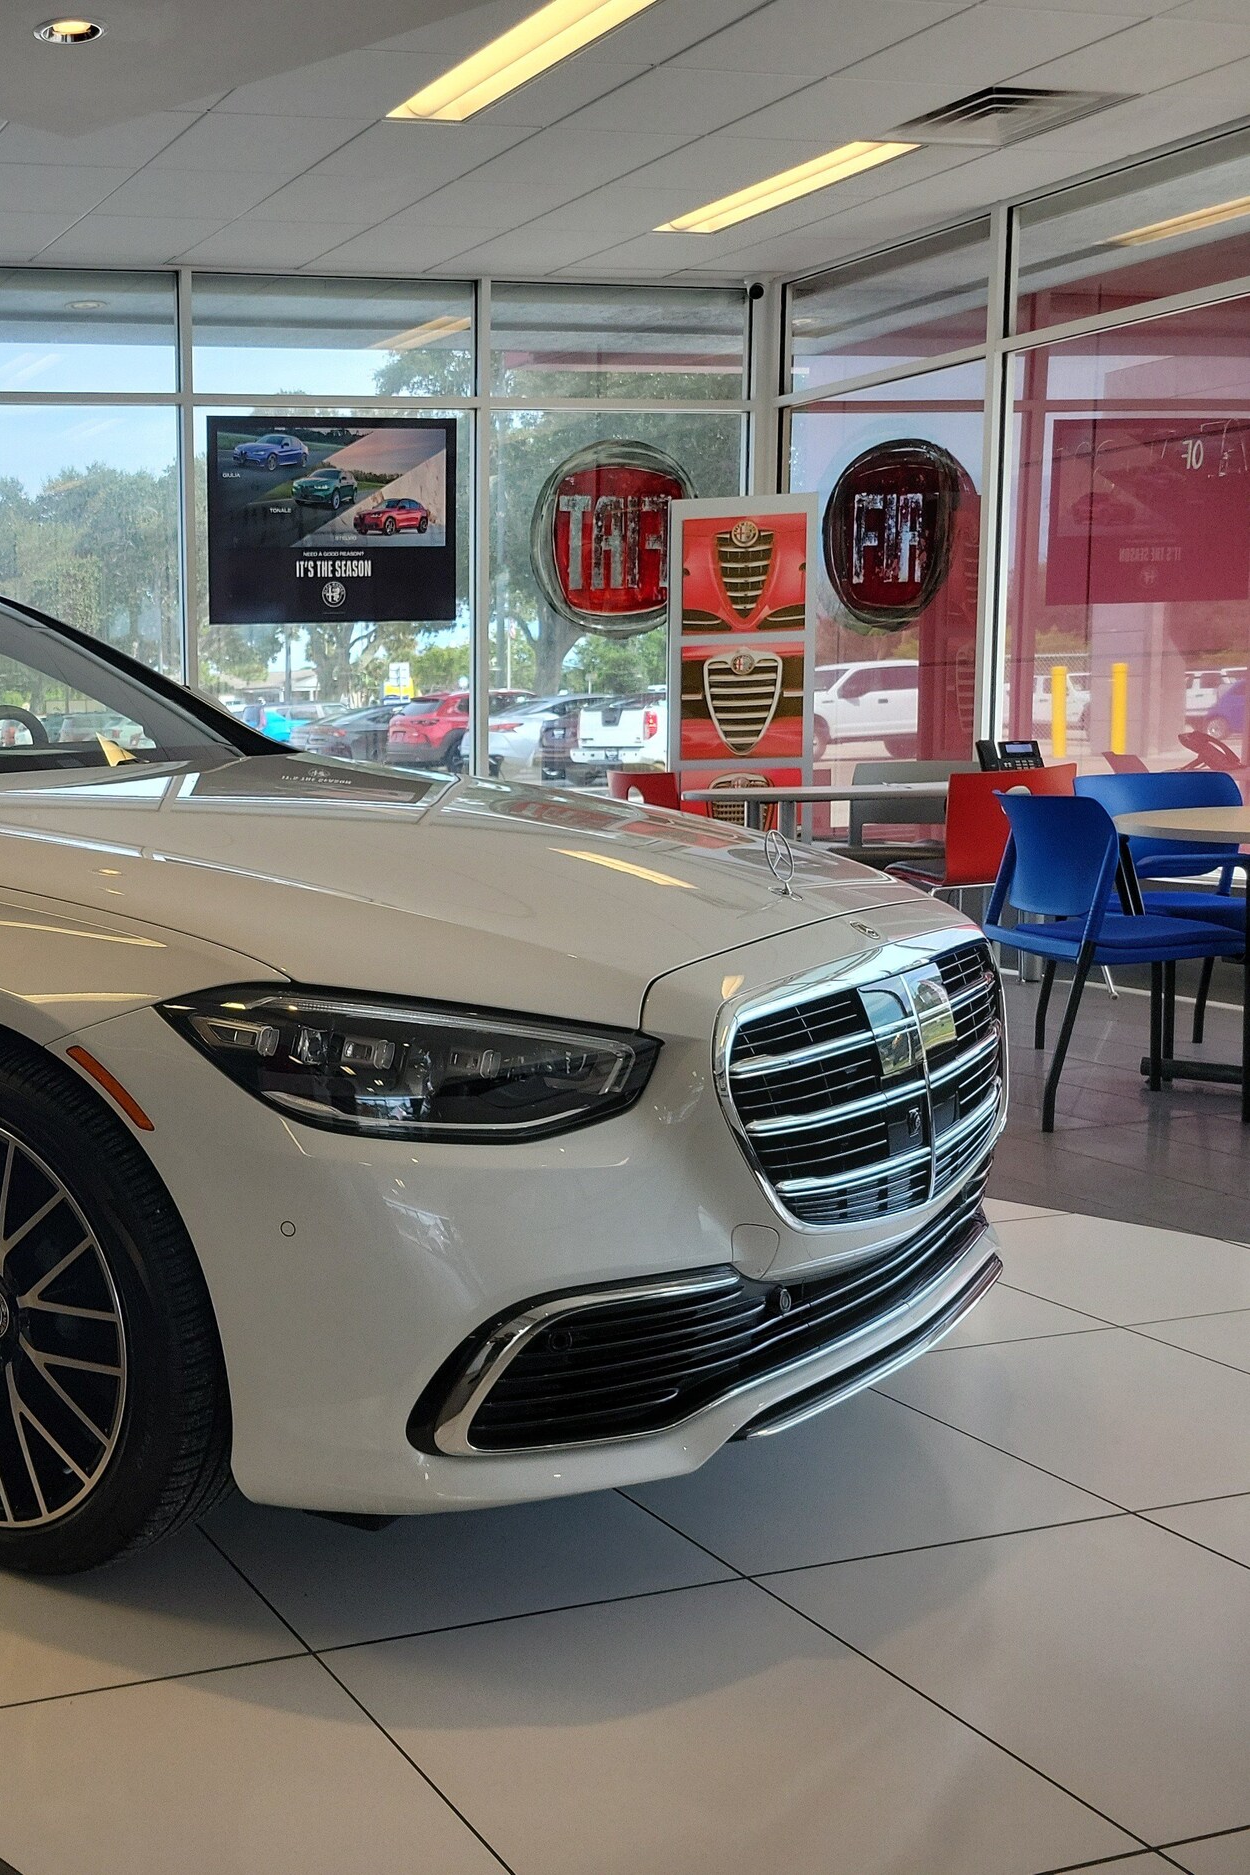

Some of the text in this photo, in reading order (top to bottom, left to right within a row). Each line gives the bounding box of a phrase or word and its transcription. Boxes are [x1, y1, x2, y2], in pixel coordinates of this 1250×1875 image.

[296, 559, 372, 578] IT'S THE SEASON
